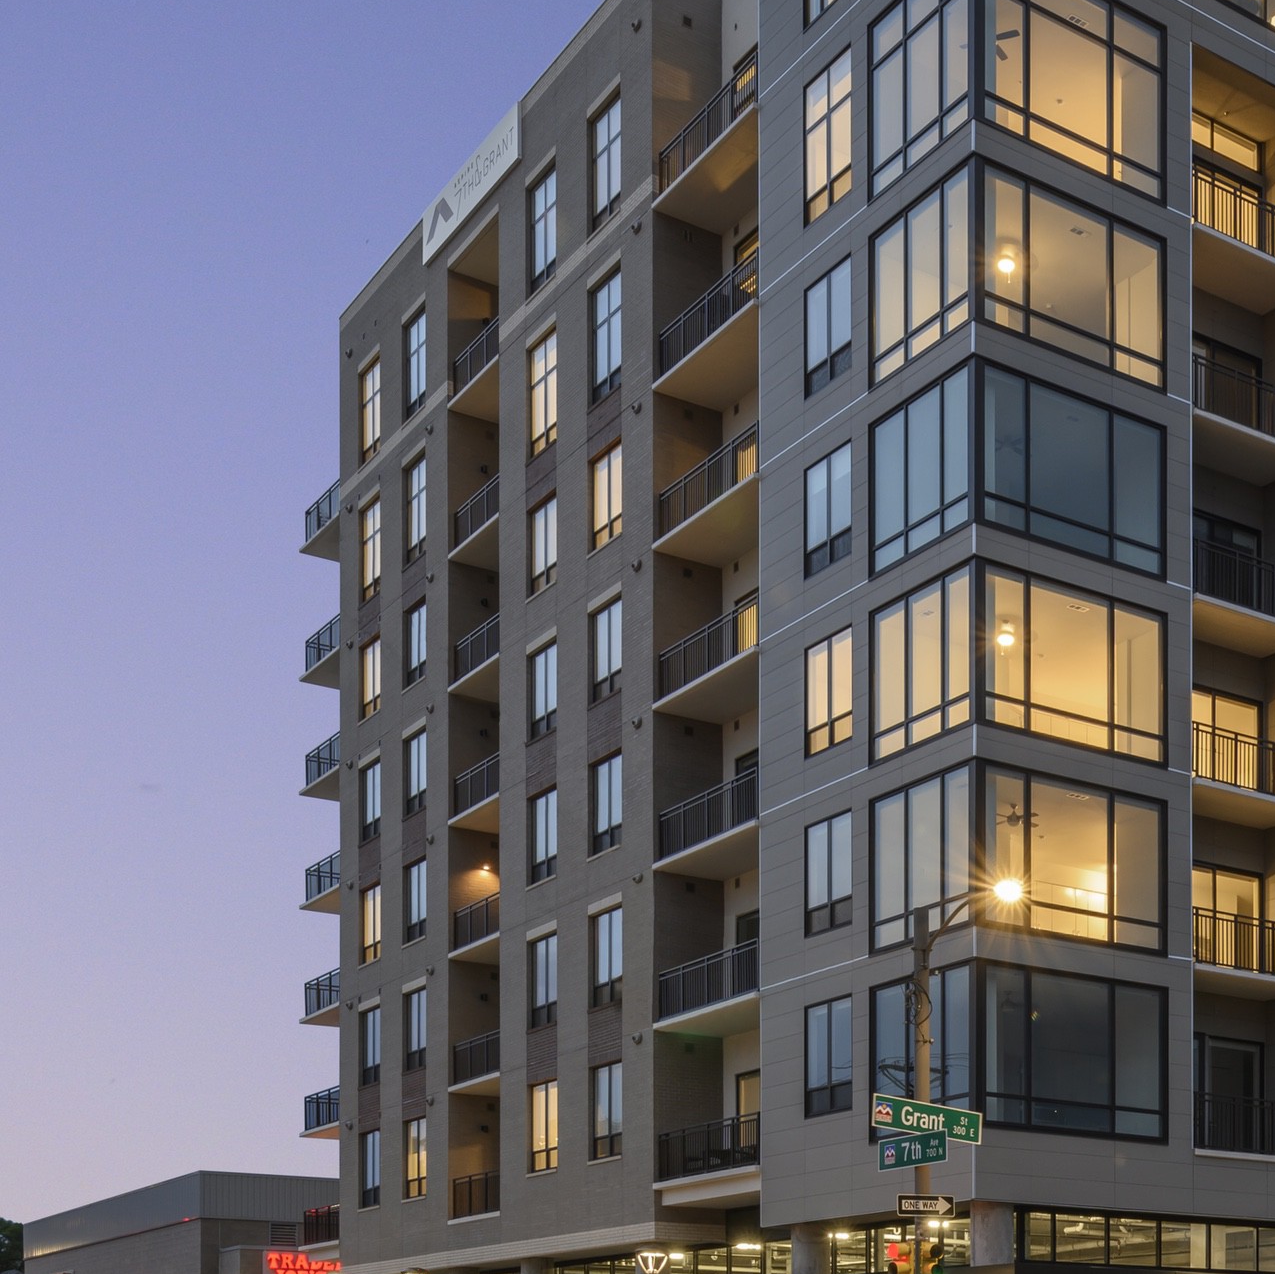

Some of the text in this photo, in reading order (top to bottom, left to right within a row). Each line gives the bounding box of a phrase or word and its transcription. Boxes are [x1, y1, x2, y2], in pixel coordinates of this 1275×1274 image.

[901, 1105, 946, 1131] Grant
[960, 1116, 969, 1126] St
[952, 1125, 975, 1138] 300 E
[901, 1141, 922, 1162] 7th
[930, 1138, 939, 1147] Ave
[926, 1147, 944, 1158] 700 N
[903, 1200, 939, 1210] ONE WAY
